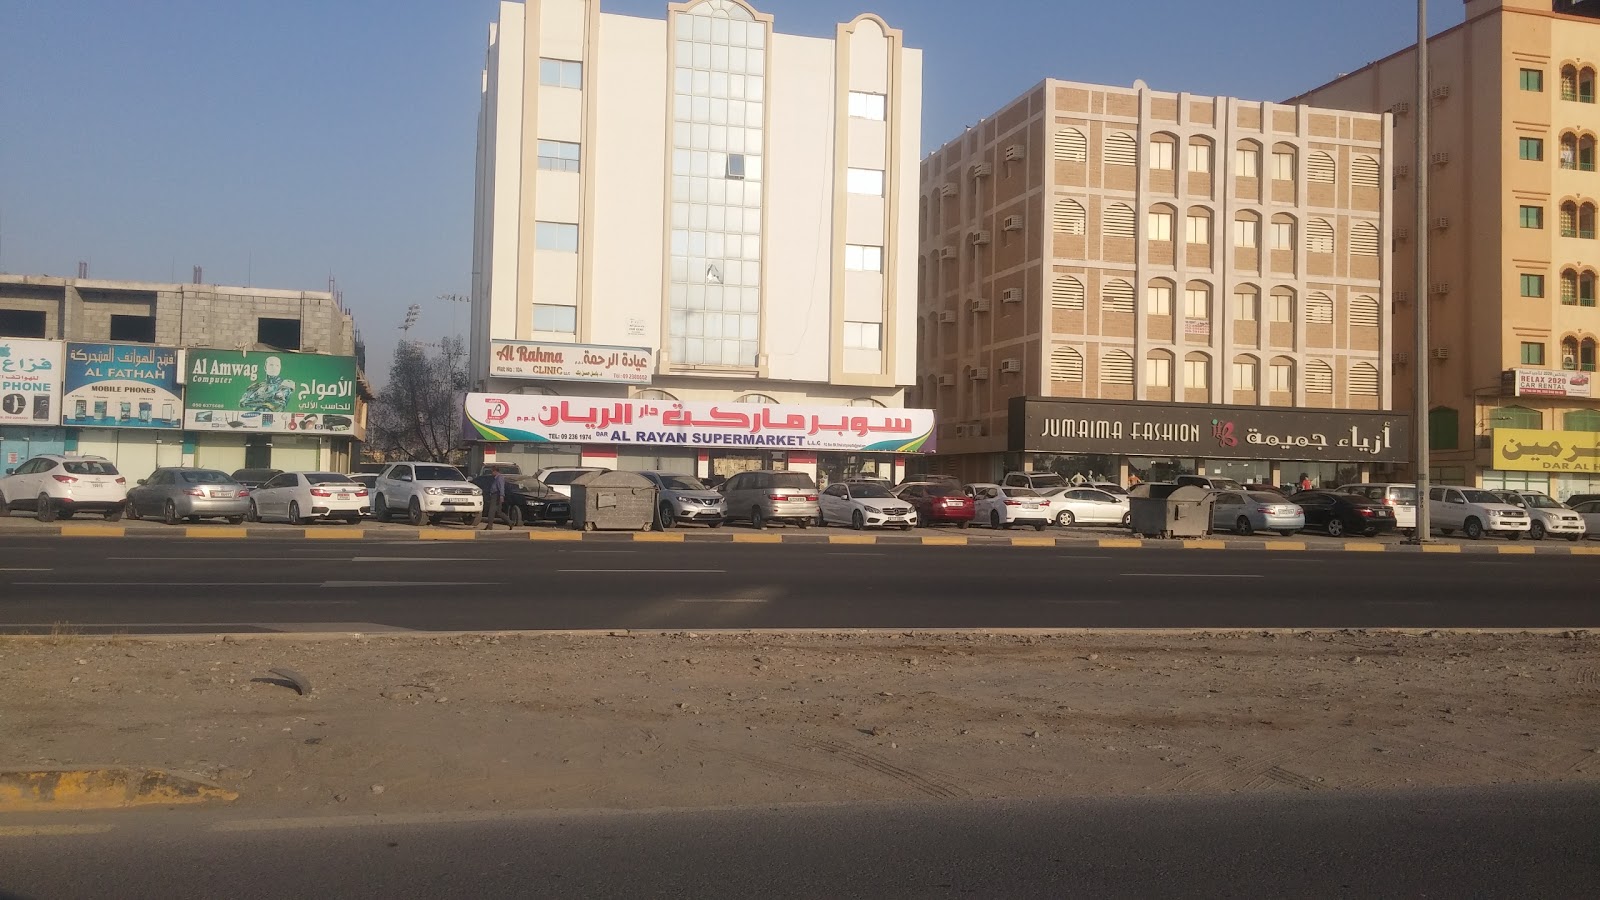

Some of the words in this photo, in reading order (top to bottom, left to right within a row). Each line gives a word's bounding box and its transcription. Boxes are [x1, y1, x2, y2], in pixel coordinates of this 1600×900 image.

[496, 345, 515, 361] Al
[516, 345, 564, 363] Rahma
[583, 350, 619, 369] الرحمة
[621, 352, 648, 372] عيادة
[84, 368, 103, 377] AL
[107, 368, 166, 379] FATHAH
[192, 358, 207, 375] Al
[209, 359, 259, 381] Amwag
[532, 365, 563, 375] CLINIC
[2, 381, 52, 392] PHONE
[192, 375, 233, 384] Computer
[1520, 375, 1546, 384] RELAX
[1547, 377, 1567, 385] 2020
[124, 386, 156, 394] PHONES
[537, 400, 633, 429] الريان
[638, 404, 659, 418] دار
[662, 403, 806, 434] ماركت
[807, 414, 912, 437] سوبر
[1041, 418, 1123, 439] JUMAIMA
[1130, 422, 1200, 442] FASHION
[610, 430, 631, 442] AL
[635, 431, 688, 443] RAYAN
[692, 432, 806, 446] SUPERMARKET
[1246, 428, 1329, 450] جميمة
[1336, 421, 1392, 454] أزياء
[1542, 462, 1570, 470] DAR
[1573, 463, 1590, 471] AL
